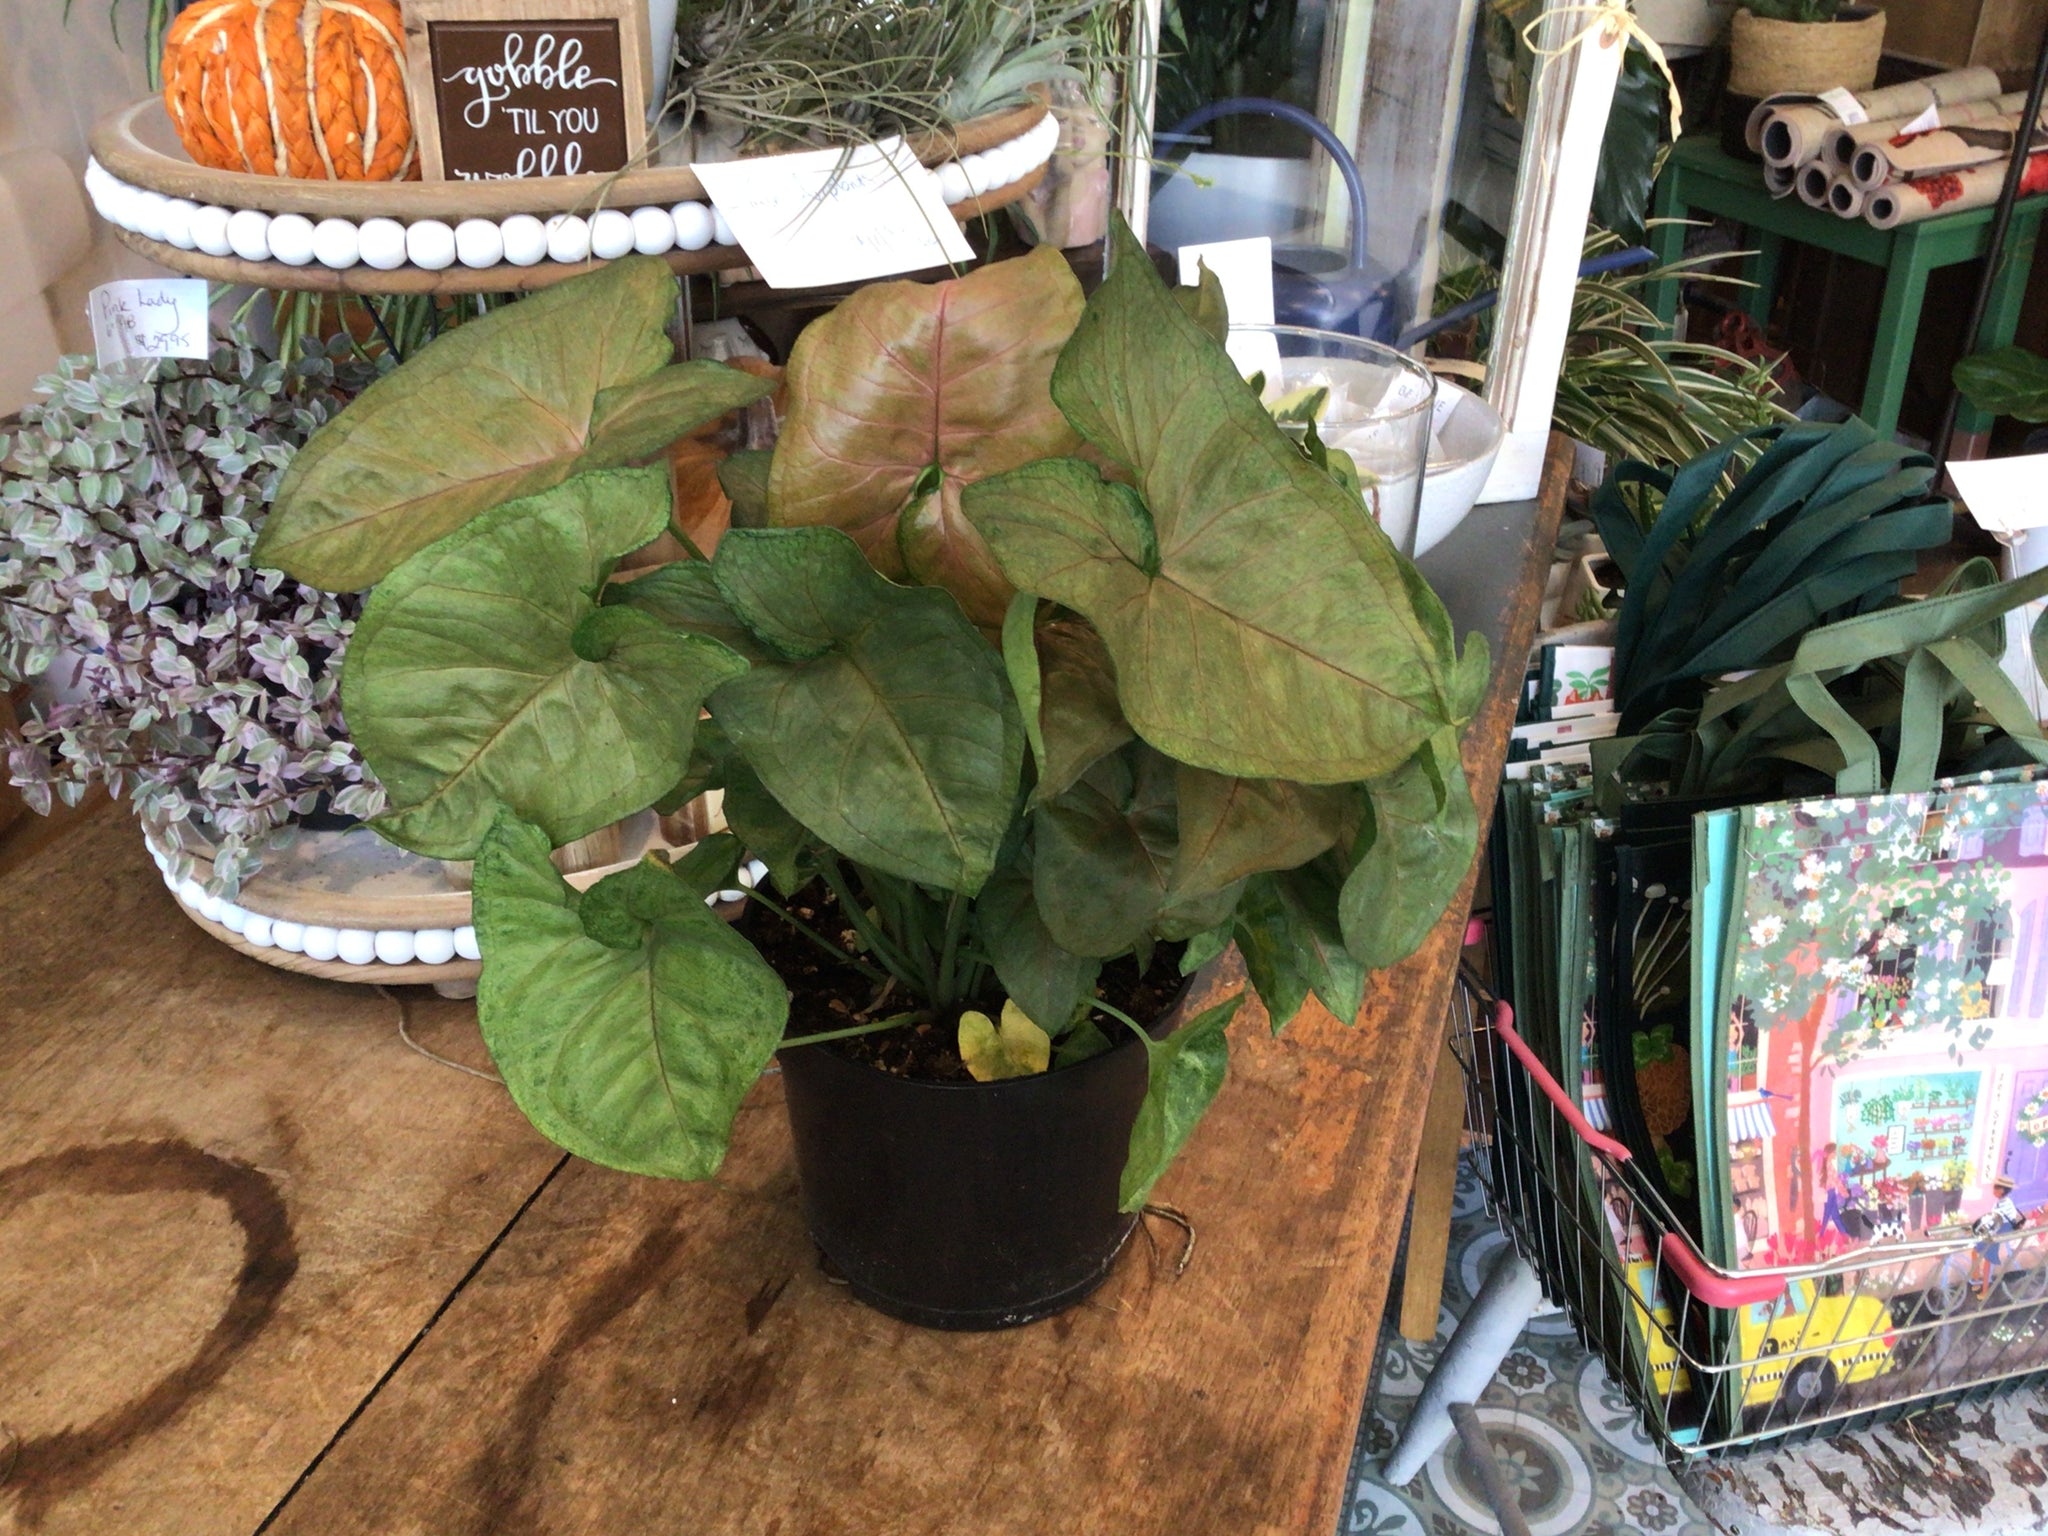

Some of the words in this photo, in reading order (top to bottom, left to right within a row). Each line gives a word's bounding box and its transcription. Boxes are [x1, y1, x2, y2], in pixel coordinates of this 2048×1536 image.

[442, 33, 617, 128] gobble
[549, 107, 599, 134] YOU
[137, 288, 180, 335] Lady
